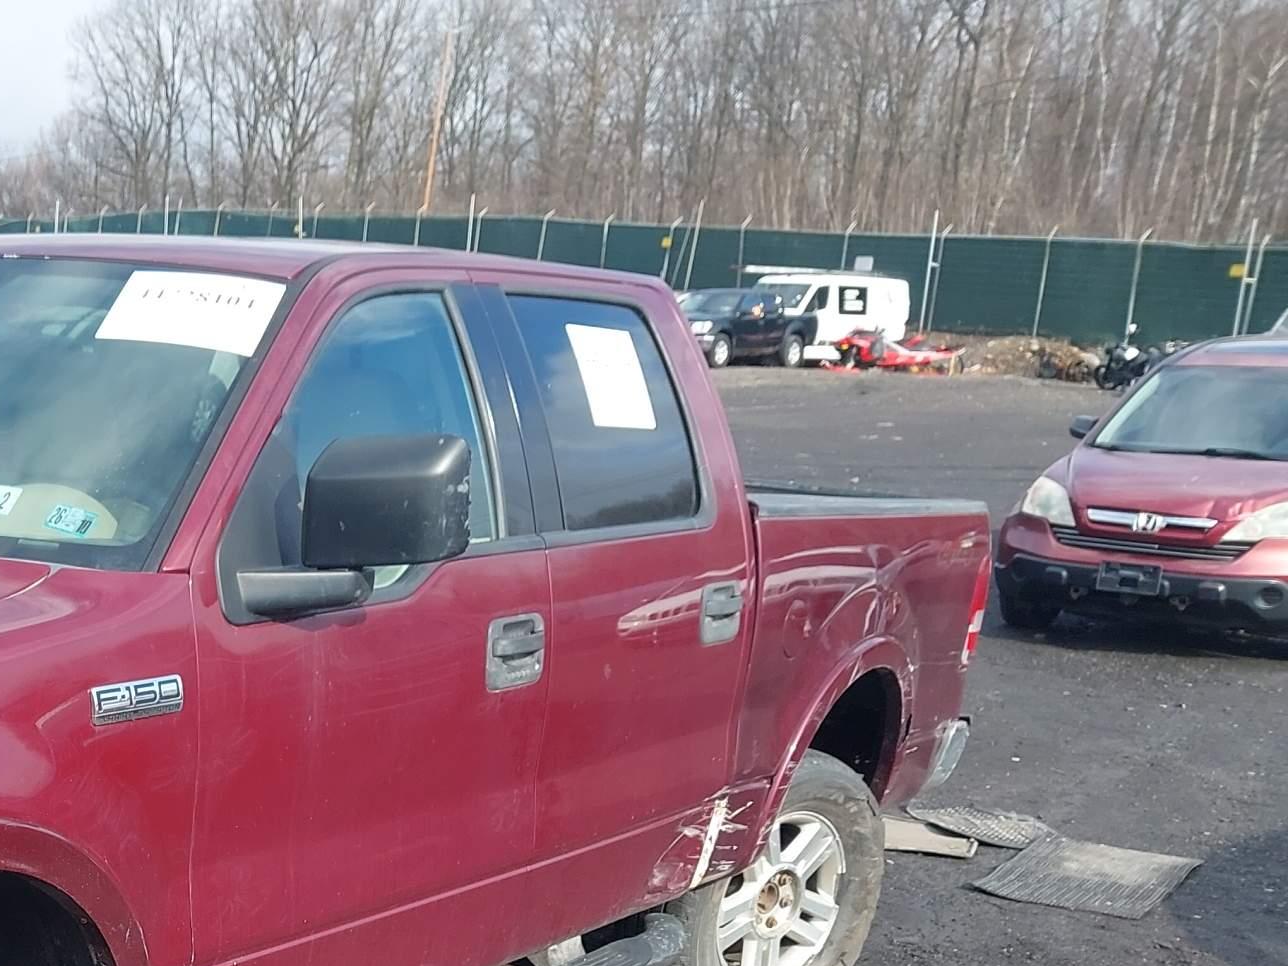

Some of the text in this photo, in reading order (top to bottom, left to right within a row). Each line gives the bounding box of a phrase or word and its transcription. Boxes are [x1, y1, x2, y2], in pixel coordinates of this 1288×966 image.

[48, 507, 67, 525] 26
[75, 519, 93, 534] 10
[95, 678, 180, 712] F-150
